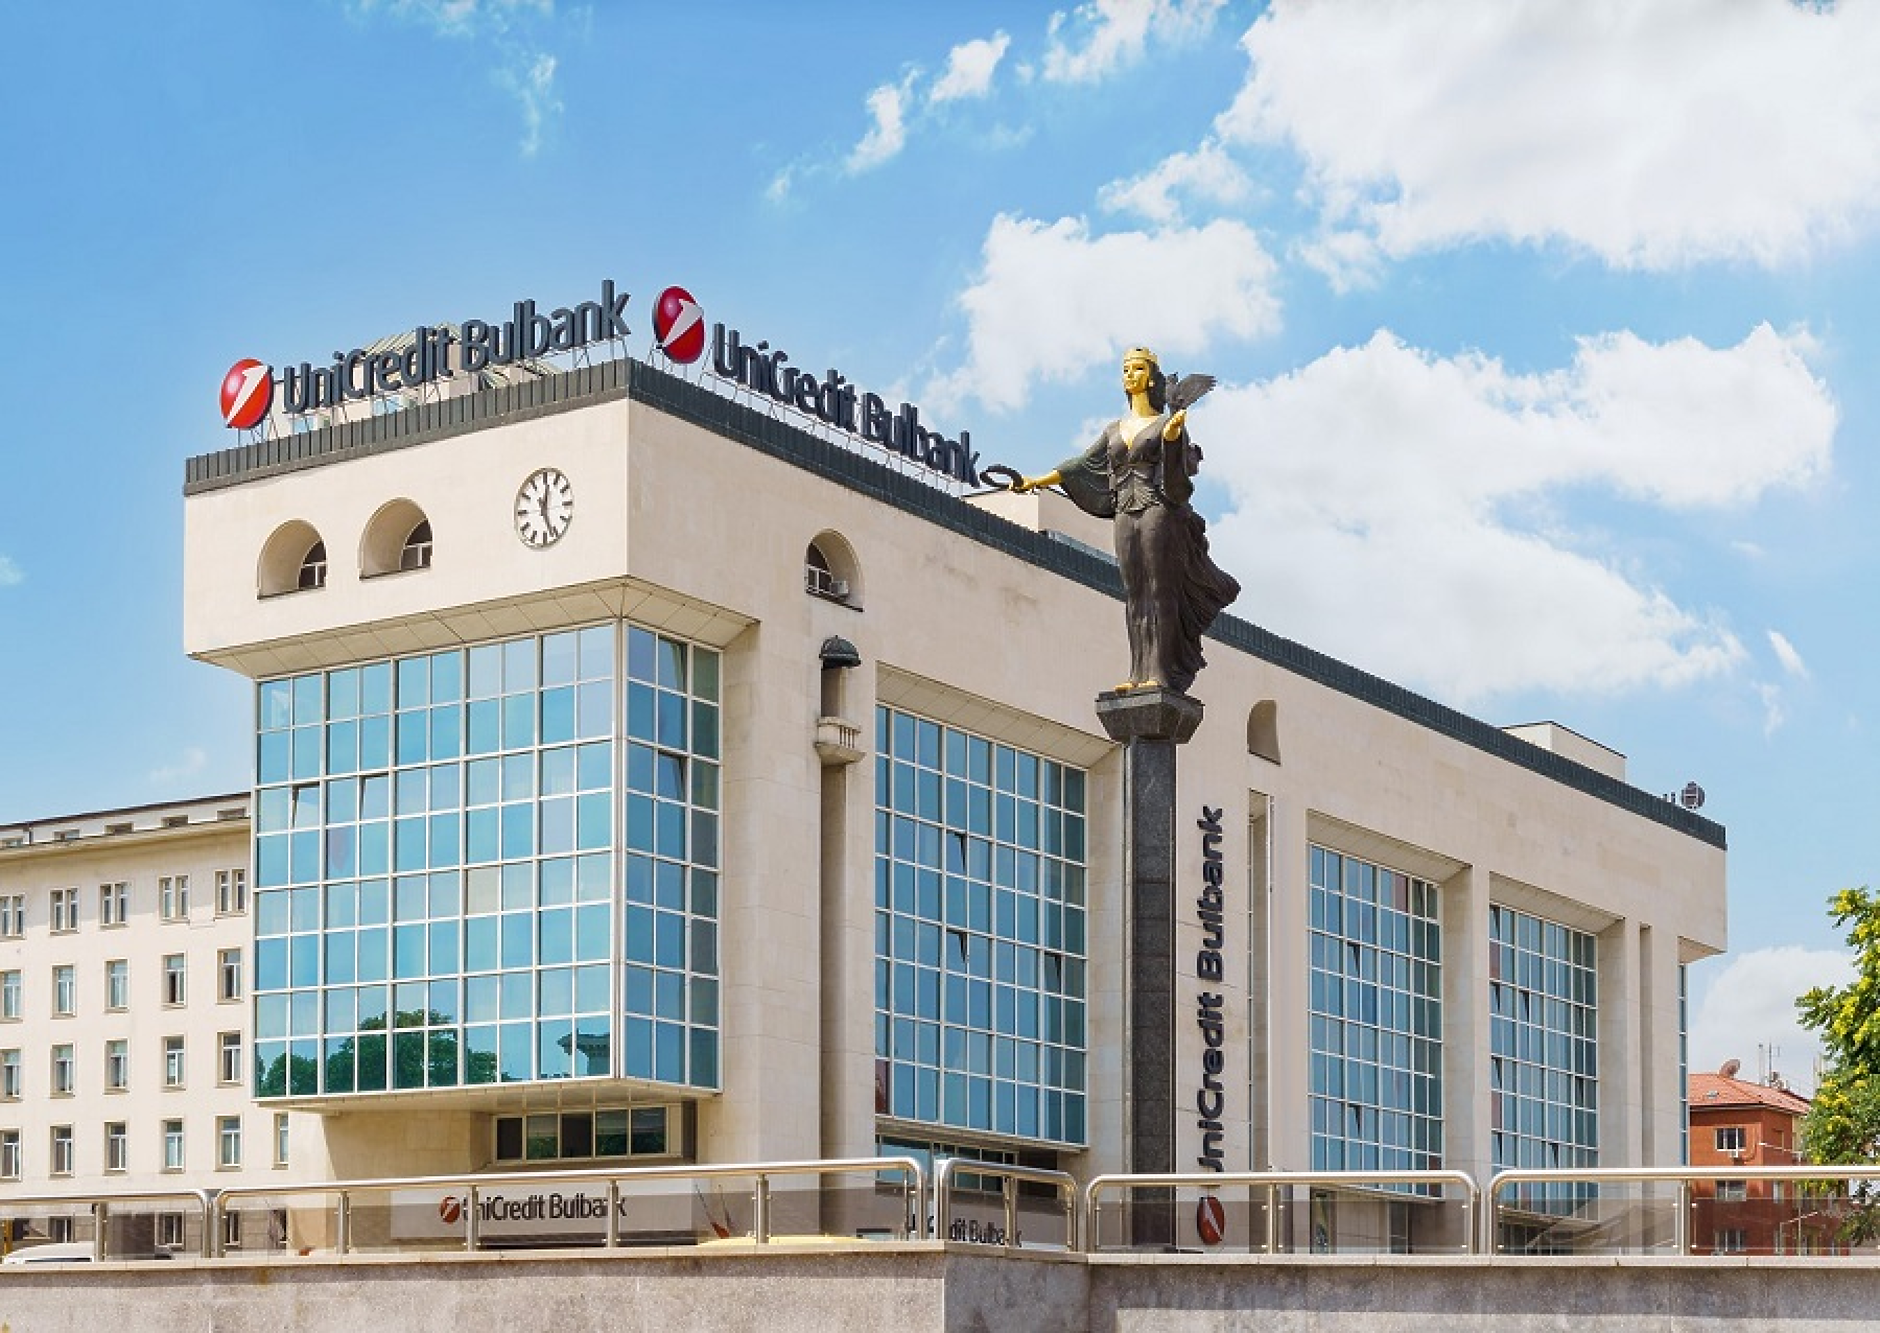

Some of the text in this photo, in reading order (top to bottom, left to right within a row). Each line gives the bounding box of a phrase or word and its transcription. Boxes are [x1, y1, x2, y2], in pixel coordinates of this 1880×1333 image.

[283, 279, 631, 413] UniCredit Bulbank
[713, 322, 980, 487] UniCredit Bulbank
[1197, 805, 1224, 982] Bulbank
[549, 1193, 627, 1219] Bulbak
